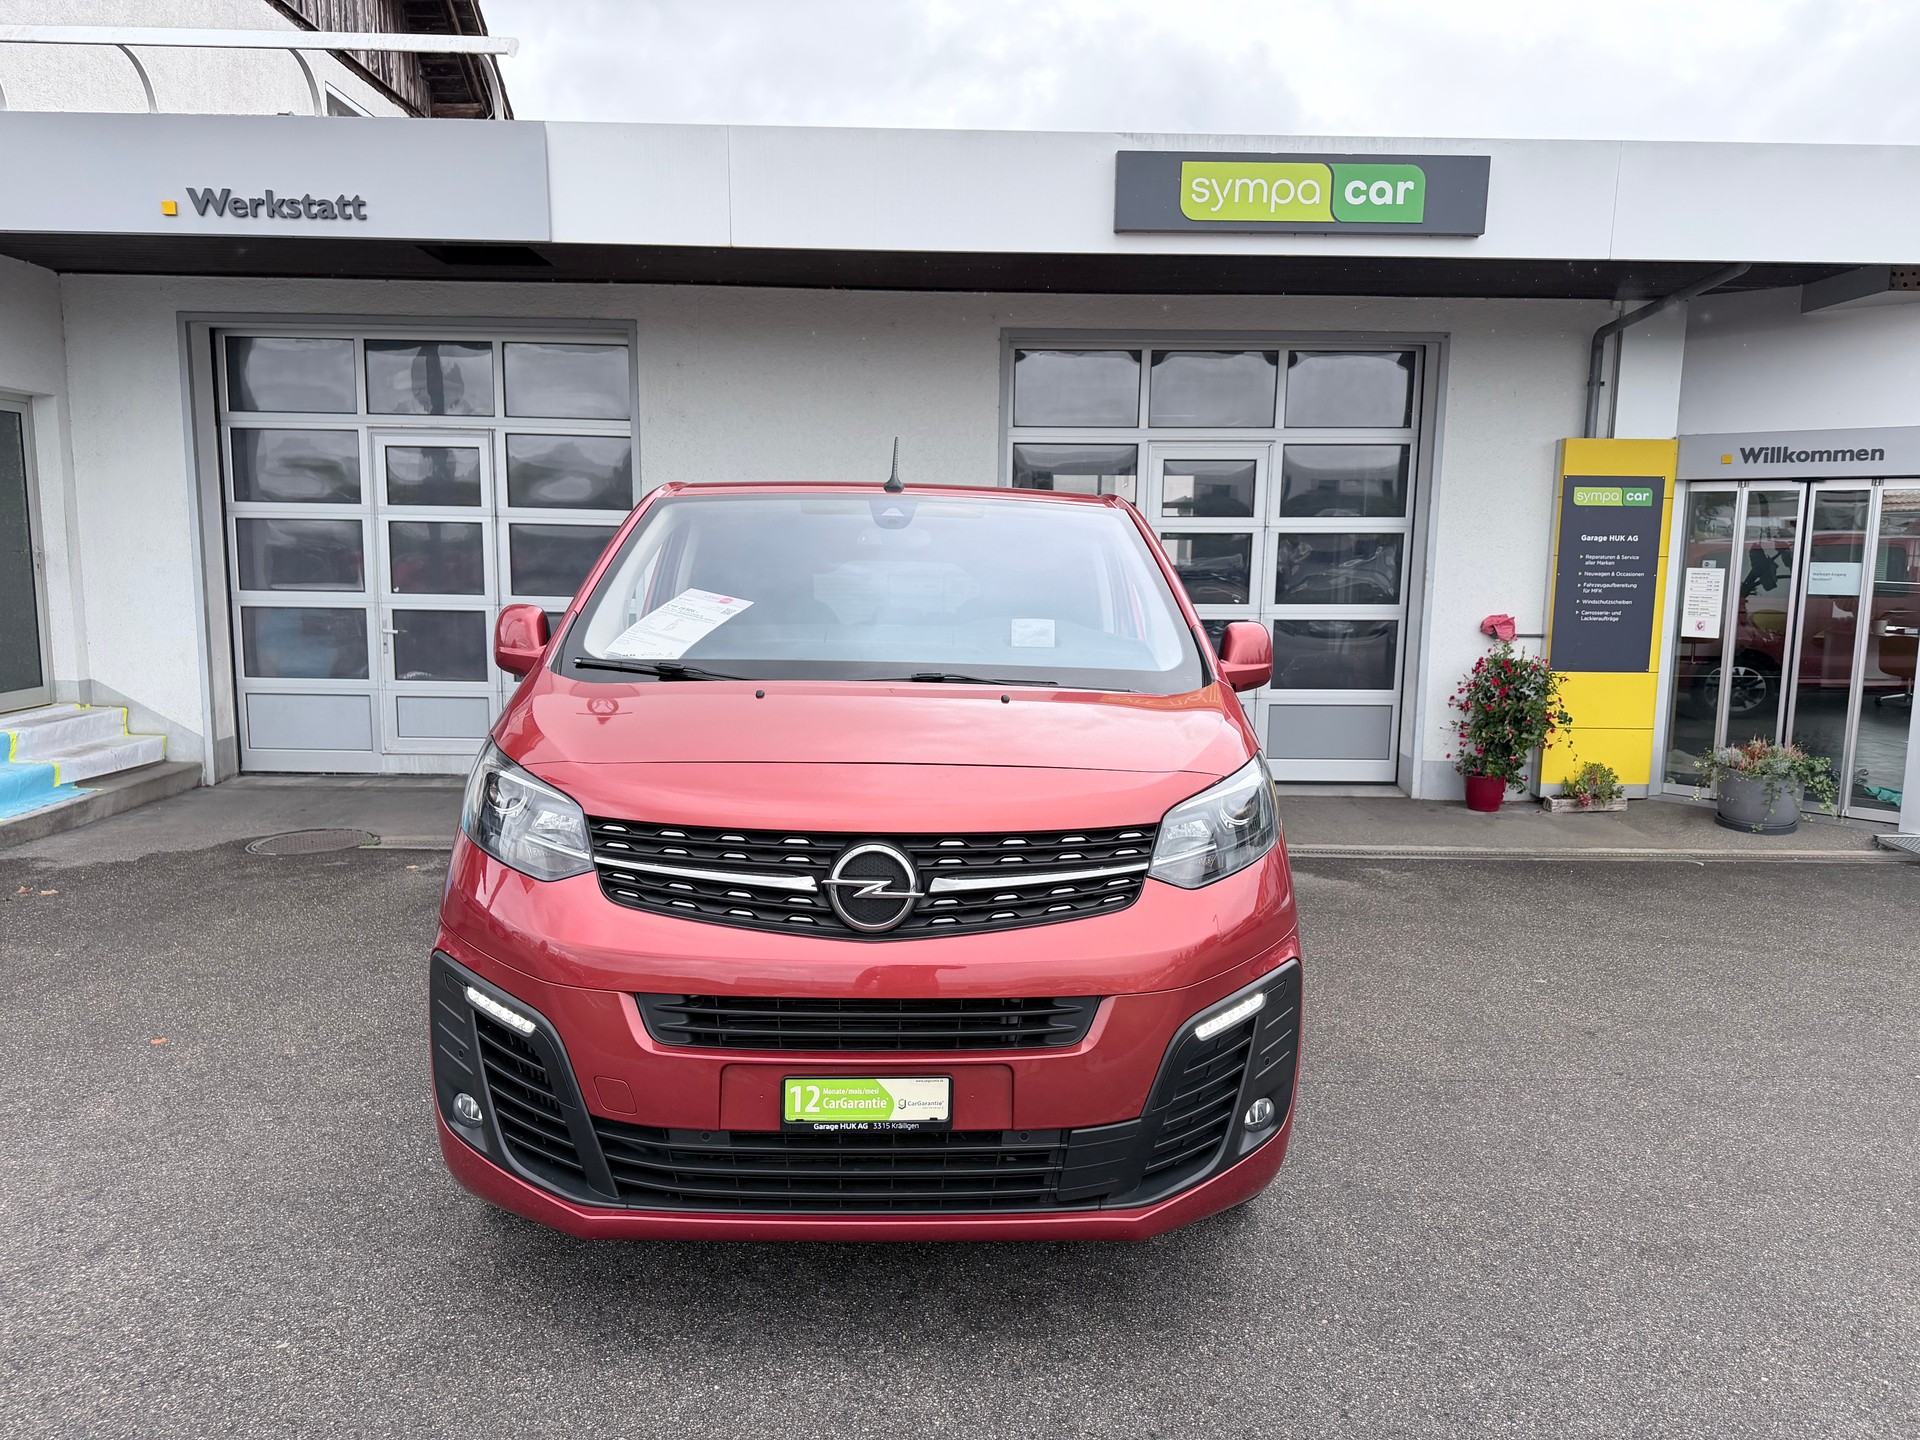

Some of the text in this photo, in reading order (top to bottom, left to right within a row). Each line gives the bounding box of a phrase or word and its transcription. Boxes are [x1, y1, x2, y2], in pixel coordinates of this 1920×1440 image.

[186, 187, 368, 221] Werkstatt
[1190, 176, 1415, 213] sympa car
[1739, 446, 1885, 465] Willkommen
[1576, 491, 1650, 503] sympa car
[1580, 534, 1608, 543] Garage
[1609, 534, 1626, 542] HUK
[789, 1085, 821, 1113] 12
[813, 1123, 839, 1131] Garage
[840, 1122, 857, 1130] HUK
[858, 1122, 869, 1130] AG
[873, 1122, 891, 1130] 3315
